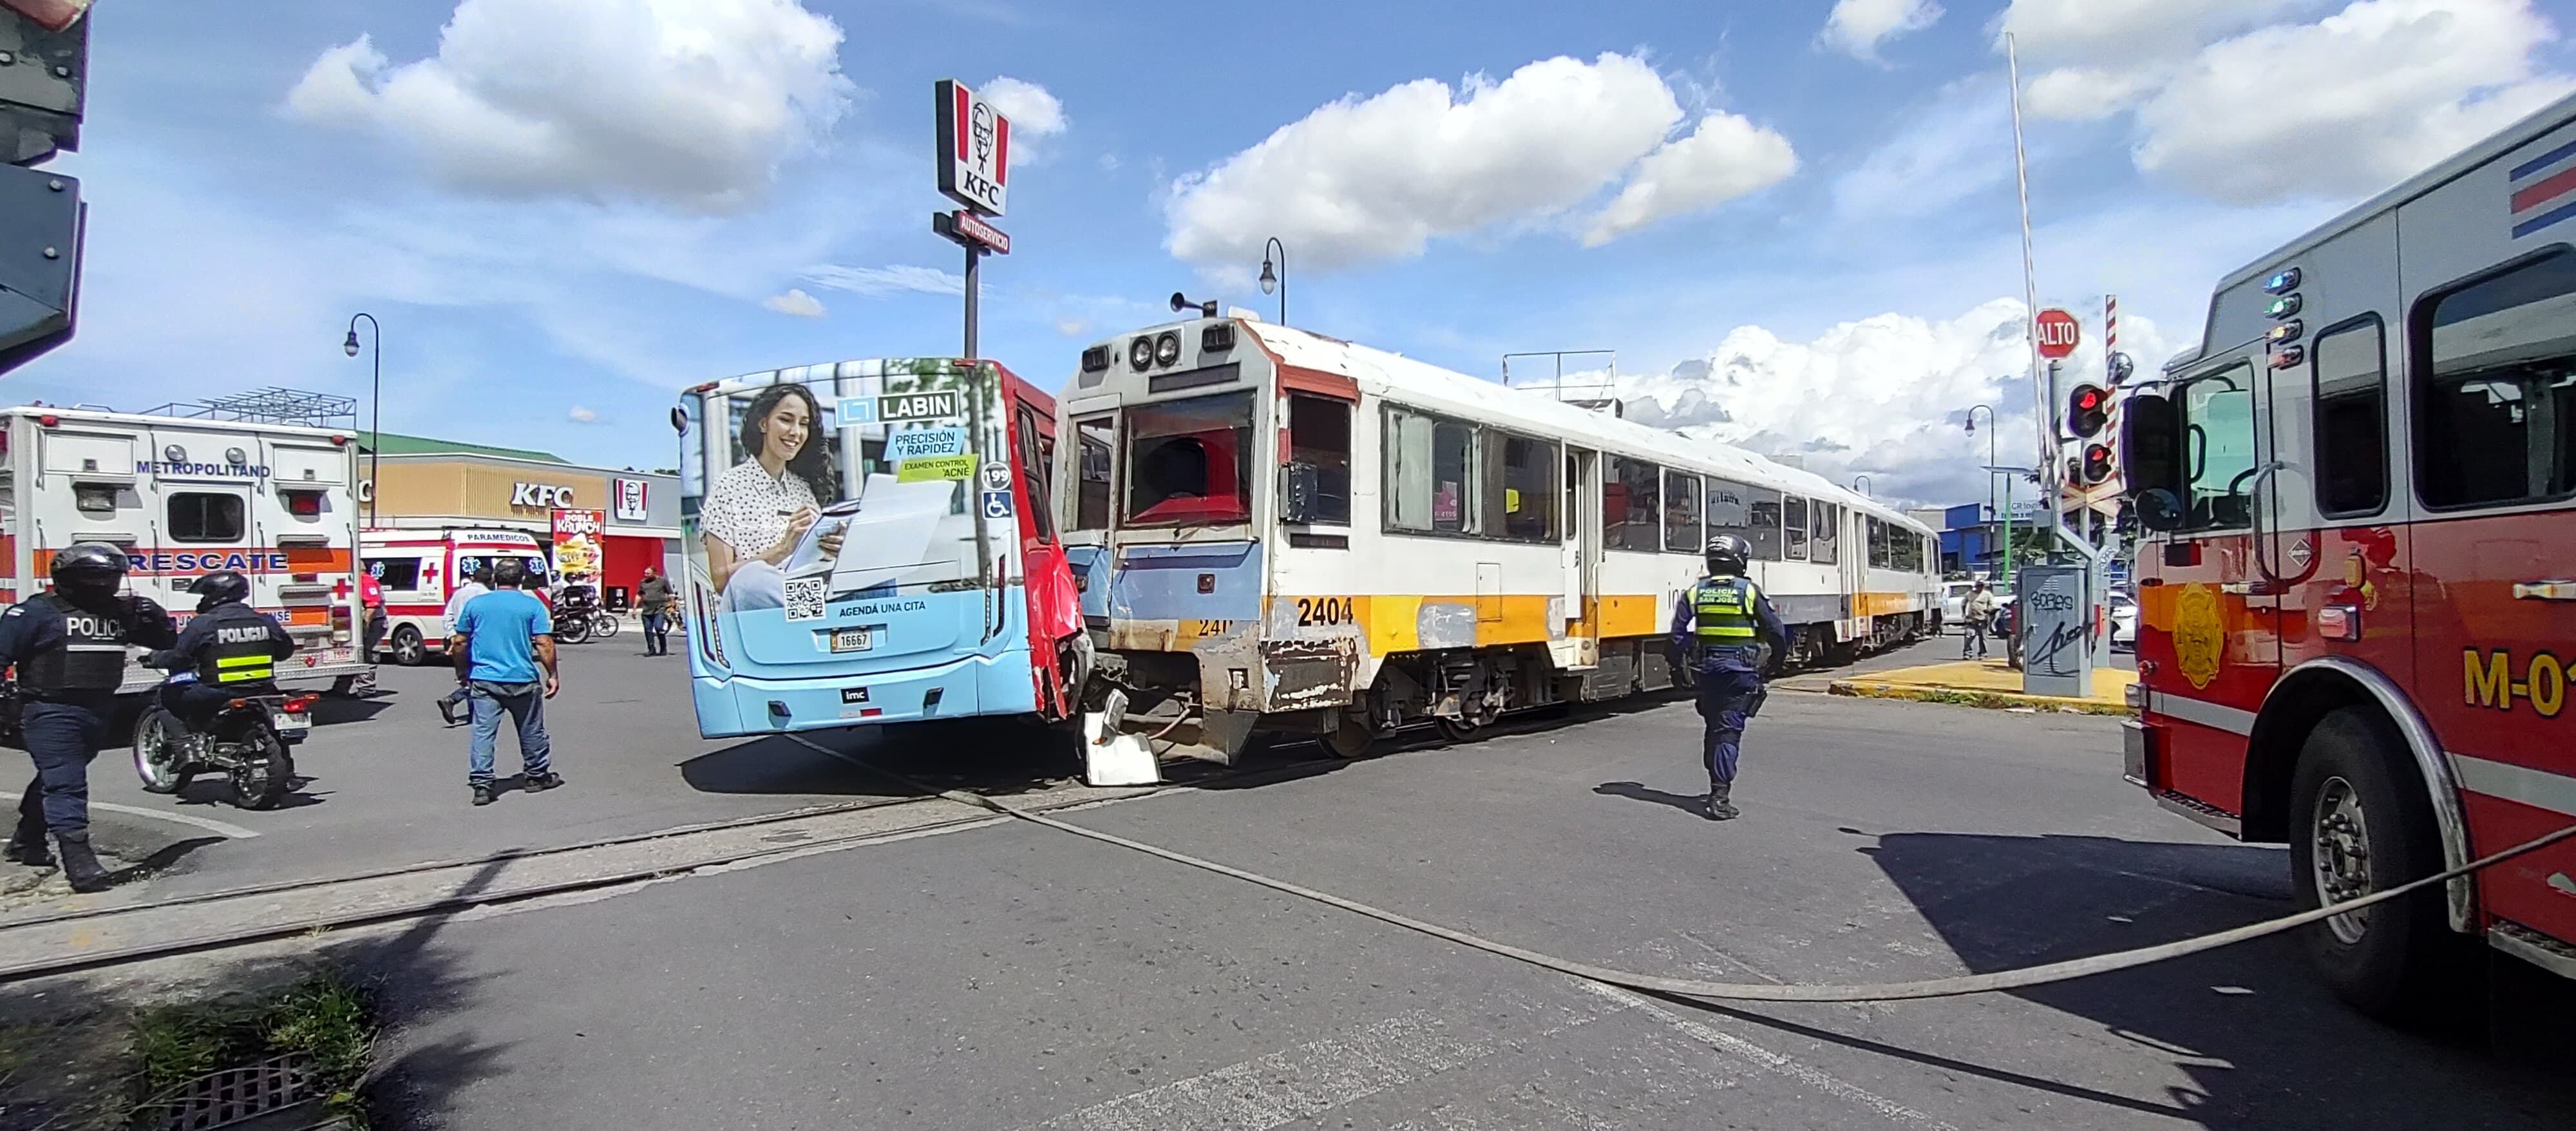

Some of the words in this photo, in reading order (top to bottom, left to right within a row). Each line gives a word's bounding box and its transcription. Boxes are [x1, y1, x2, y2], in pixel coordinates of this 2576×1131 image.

[963, 170, 999, 206] KFC
[960, 216, 1008, 250] AUTOSERVICIO
[2037, 322, 2074, 345] ALTO
[883, 395, 951, 419] LABIN
[895, 430, 955, 445] PRECISIÓN
[896, 446, 905, 456] Y
[907, 442, 954, 455] RAPIDEZ
[137, 461, 270, 478] METROPOLITANO
[904, 461, 934, 470] EXAMEN
[935, 459, 969, 468] CONTROL
[985, 469, 1009, 482] 199
[511, 482, 574, 508] KFC
[556, 519, 600, 534] KRUNCH
[468, 534, 529, 542] PARAMEDICOS
[128, 552, 289, 571] RESCATE
[840, 603, 878, 617] AGENDÁ
[881, 604, 902, 613] UNA
[904, 601, 926, 611] CITA
[1298, 597, 1353, 627] 2404
[218, 626, 270, 643] POLICIA
[841, 634, 867, 647] 16667
[2463, 648, 2576, 718] M-0
[846, 690, 866, 700] imc
